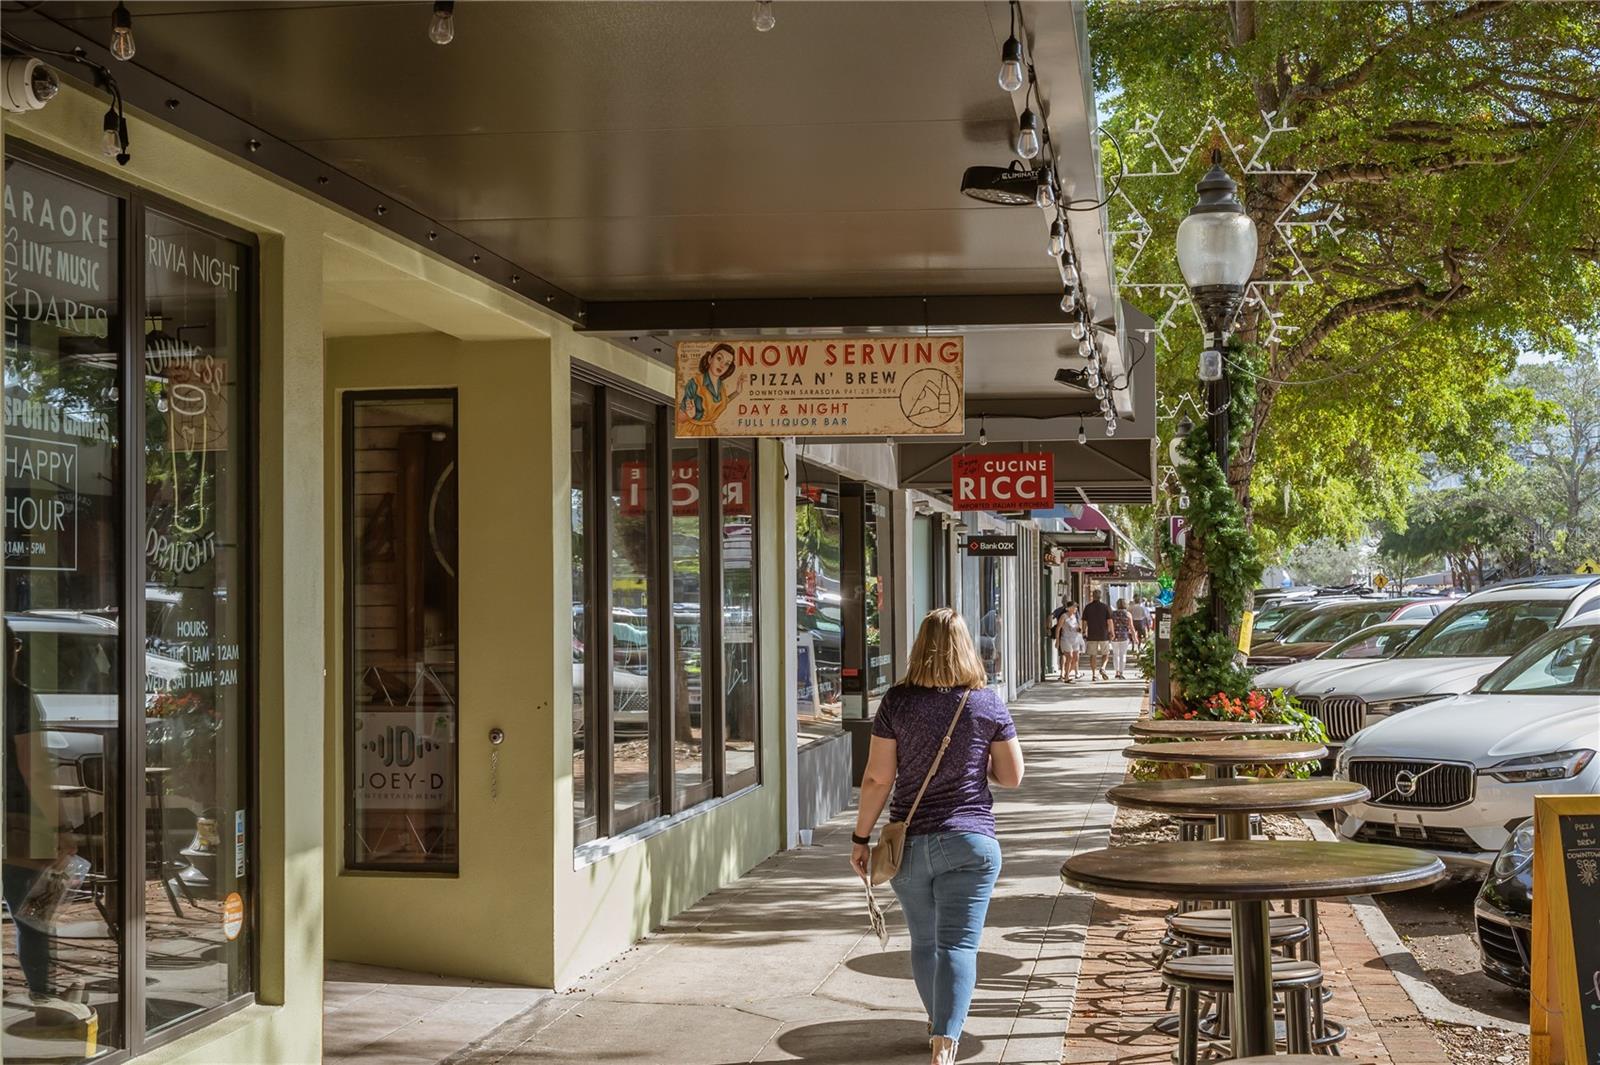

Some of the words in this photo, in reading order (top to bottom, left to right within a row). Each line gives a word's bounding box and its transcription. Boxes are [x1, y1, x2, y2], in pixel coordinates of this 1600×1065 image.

[4, 184, 108, 248] ARAOKE
[22, 239, 52, 278] LIVE
[57, 250, 100, 292] MUSIC
[193, 251, 240, 292] NIGHT
[4, 223, 18, 374] ILLIARDS
[23, 287, 108, 339] DARTS
[740, 344, 808, 367] NOW
[824, 341, 960, 366] SERVING
[750, 373, 802, 387] PIZZA
[846, 371, 897, 385] BREW
[749, 389, 797, 398] DOWNTOWN
[799, 388, 841, 397] SARASOTA
[738, 403, 771, 416] DAY
[780, 403, 790, 415] &
[798, 402, 849, 416] NIGHT
[4, 396, 60, 433] SPORTS
[63, 406, 110, 442] GAMES
[738, 418, 764, 427] FULL
[770, 418, 819, 427] LIQUOR
[824, 417, 848, 426] BAR
[4, 445, 74, 483] HAPPY
[984, 460, 1047, 473] CUCINE
[960, 475, 1047, 500] RICCI
[4, 496, 65, 531] HOUR
[30, 542, 46, 554] 5PM
[145, 527, 216, 573] DRAUGHT
[177, 621, 208, 637] HOURS:
[217, 644, 240, 660] 12AM
[190, 671, 213, 688] 11AM
[219, 669, 238, 686] 2AM
[358, 772, 444, 790] JOEY-D
[359, 792, 444, 801] NTERTAINMENT
[1567, 851, 1600, 859] DOWNTOW
